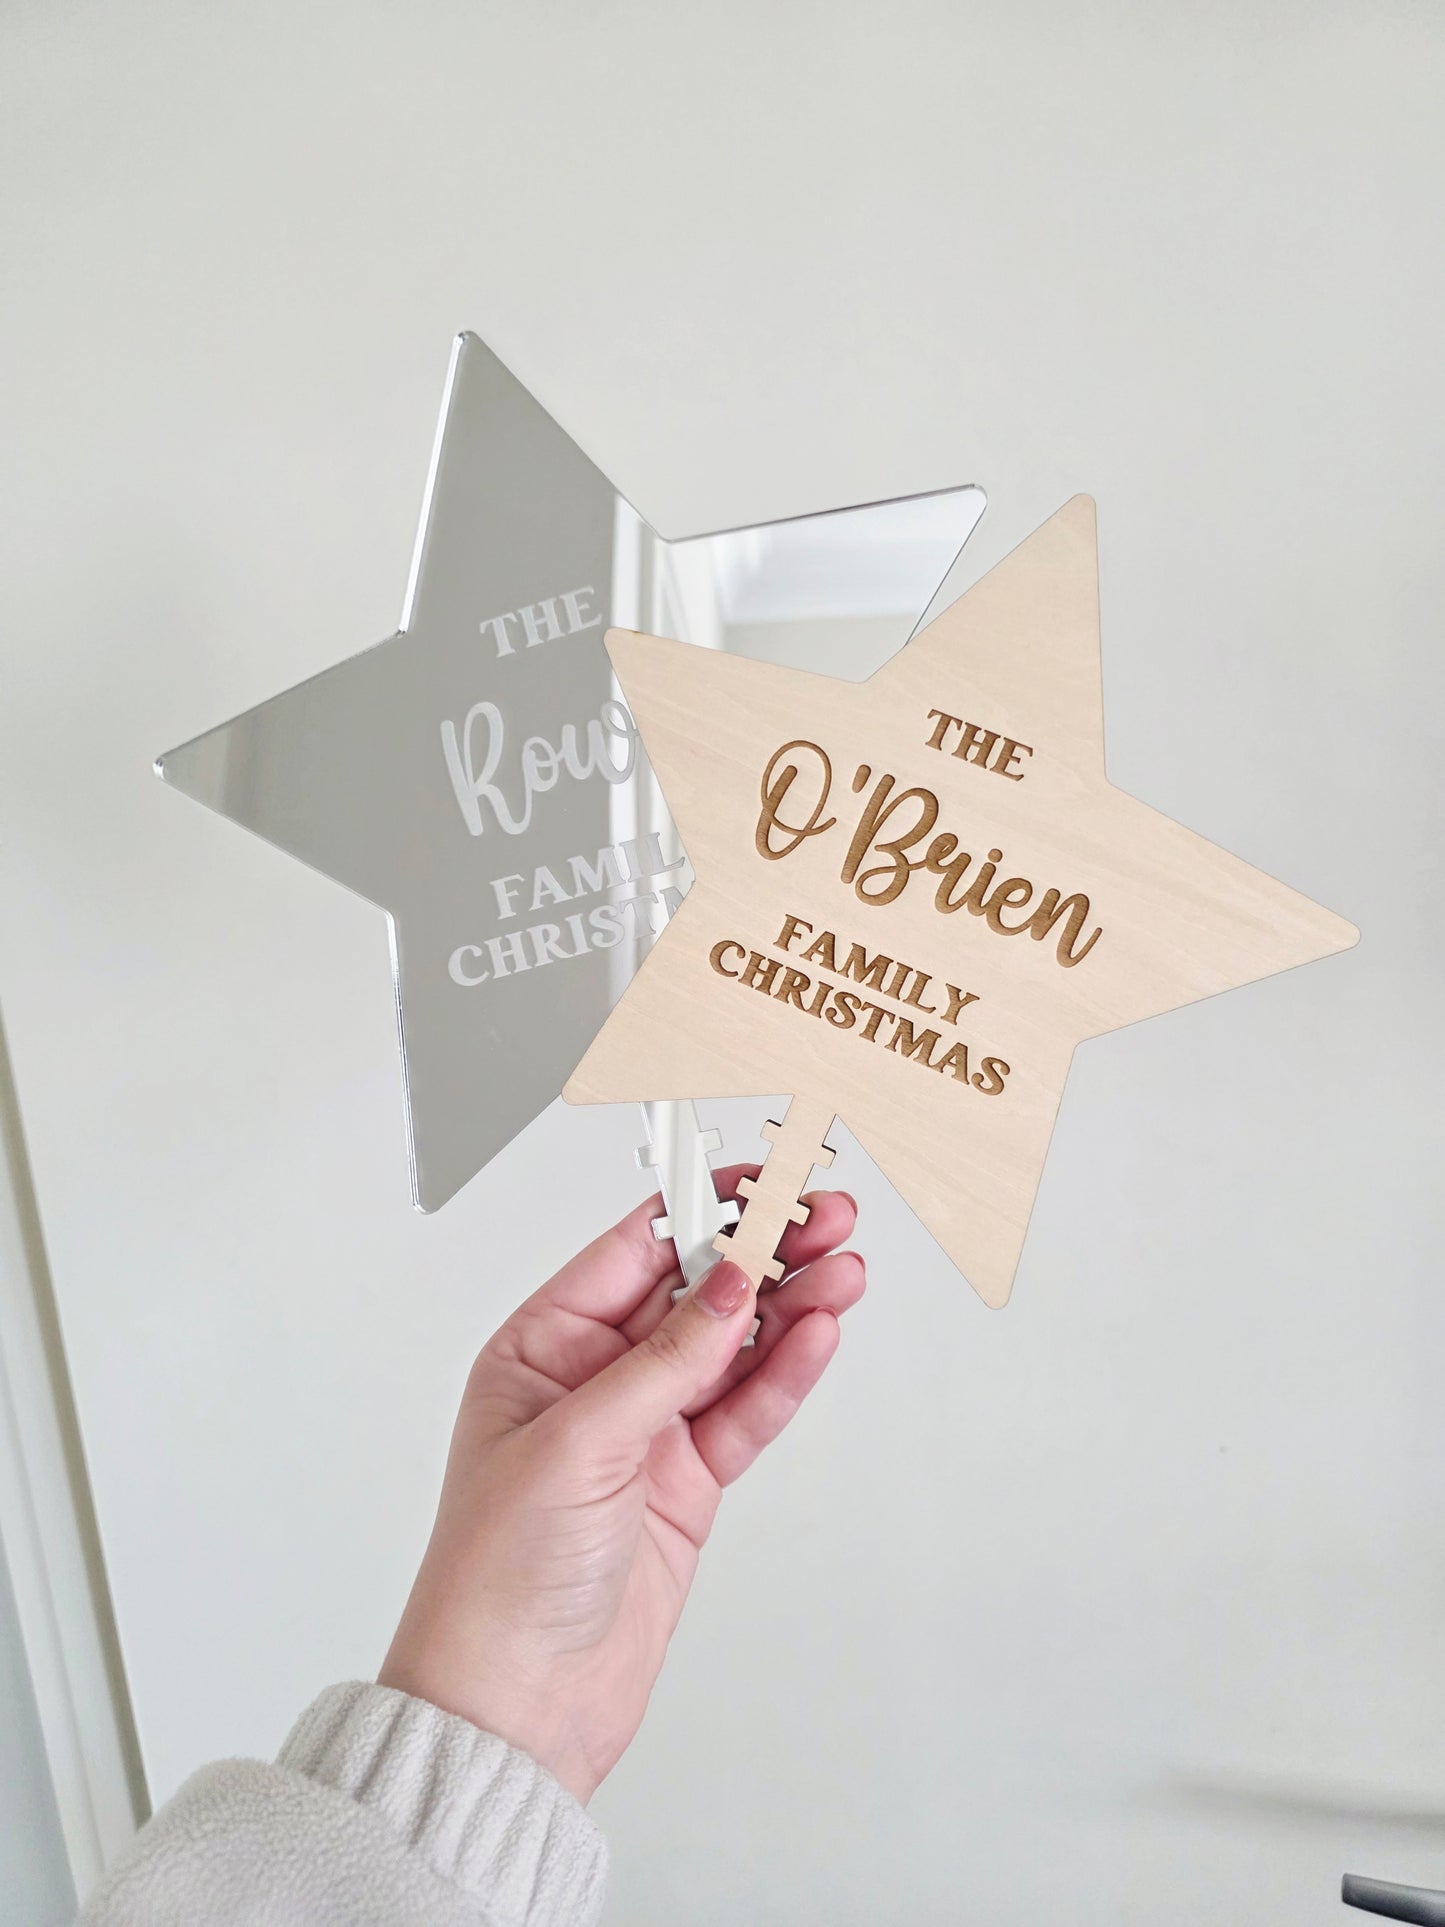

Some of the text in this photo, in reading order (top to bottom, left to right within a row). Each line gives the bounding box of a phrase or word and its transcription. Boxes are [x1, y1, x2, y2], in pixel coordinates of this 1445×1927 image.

[479, 585, 603, 659] THE
[925, 708, 1034, 782] THE
[489, 831, 687, 921] FAMIL
[755, 739, 1103, 969] O'Brien
[708, 939, 1011, 1097] CHRISTMAS
[773, 913, 981, 1026] FAMILY
